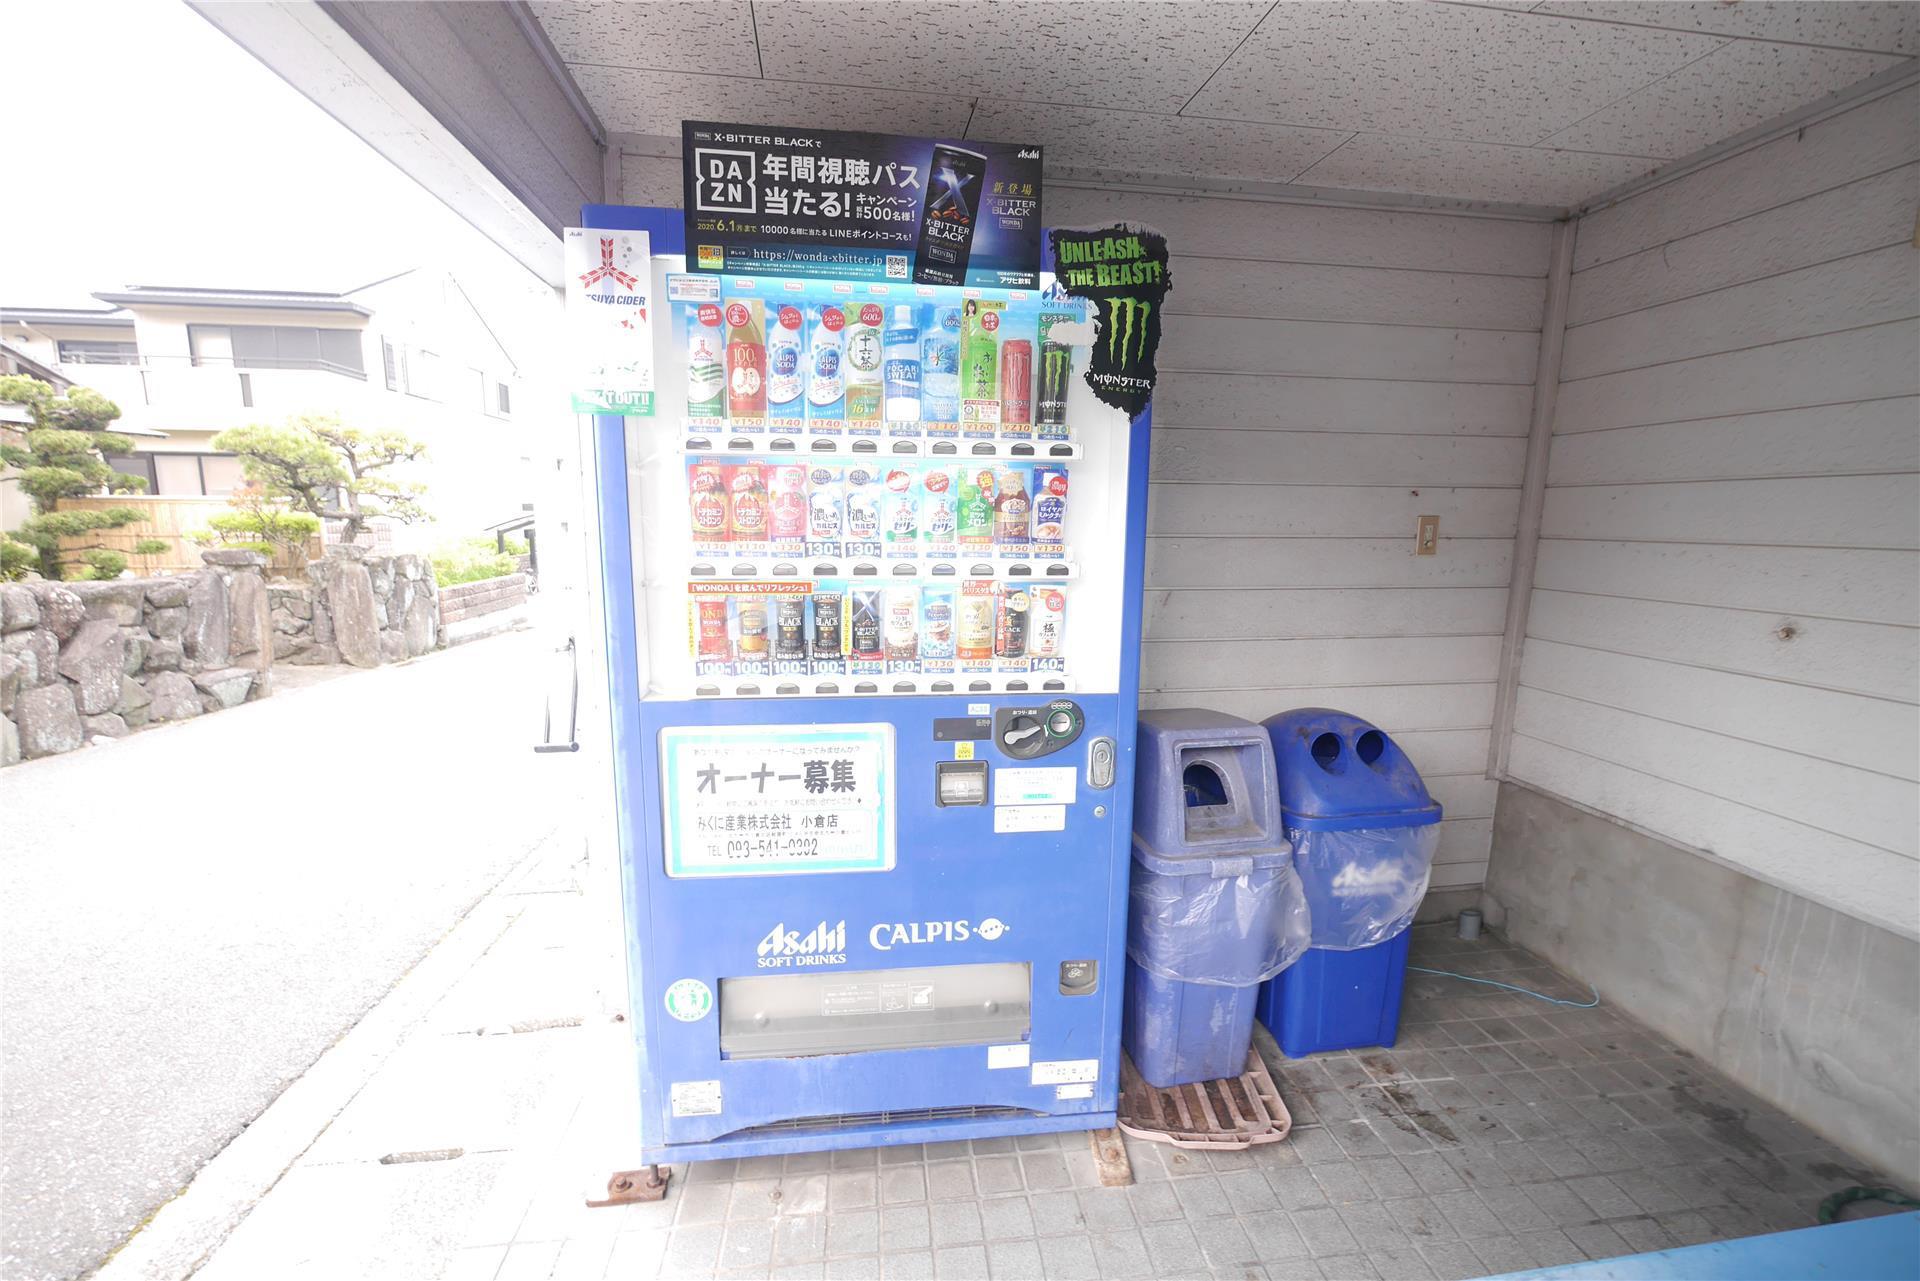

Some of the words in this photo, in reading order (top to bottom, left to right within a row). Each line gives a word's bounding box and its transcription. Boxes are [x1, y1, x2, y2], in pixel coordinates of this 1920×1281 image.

[714, 133, 771, 145] X-BITTER
[775, 136, 814, 148] BLACK
[1018, 149, 1040, 159] Asahi
[709, 159, 743, 180] DA
[762, 153, 921, 190] 年間視聴パス
[711, 182, 743, 203] ZN
[992, 181, 1033, 196] 新登場
[764, 186, 850, 218] 当たる!
[856, 192, 918, 208] キャンペーン
[986, 197, 1037, 209] X-BITTER
[991, 205, 1031, 217] BLACK
[925, 217, 970, 236] X-BITTER
[928, 223, 965, 243] BLACK
[753, 248, 883, 265] https://wonda-xbitter.jp
[1059, 236, 1141, 264] UNLEASH
[1067, 268, 1095, 287] THE
[616, 294, 646, 306] CIDER
[1041, 301, 1060, 309] SOFT
[886, 364, 919, 373] POCARI
[887, 371, 917, 380] SWEAT
[1093, 372, 1151, 390] MONSTER
[778, 616, 802, 626] BLACK
[815, 616, 839, 626] BLACK
[696, 759, 857, 794] オーナー募集
[698, 813, 792, 832] みくに産業株式会社
[801, 813, 839, 829] 小倉店
[707, 845, 722, 857] TEL
[757, 919, 847, 957] Asahi
[869, 919, 971, 951] CALPIS
[757, 955, 793, 968] SOFT
[796, 953, 847, 966] DRINKS
